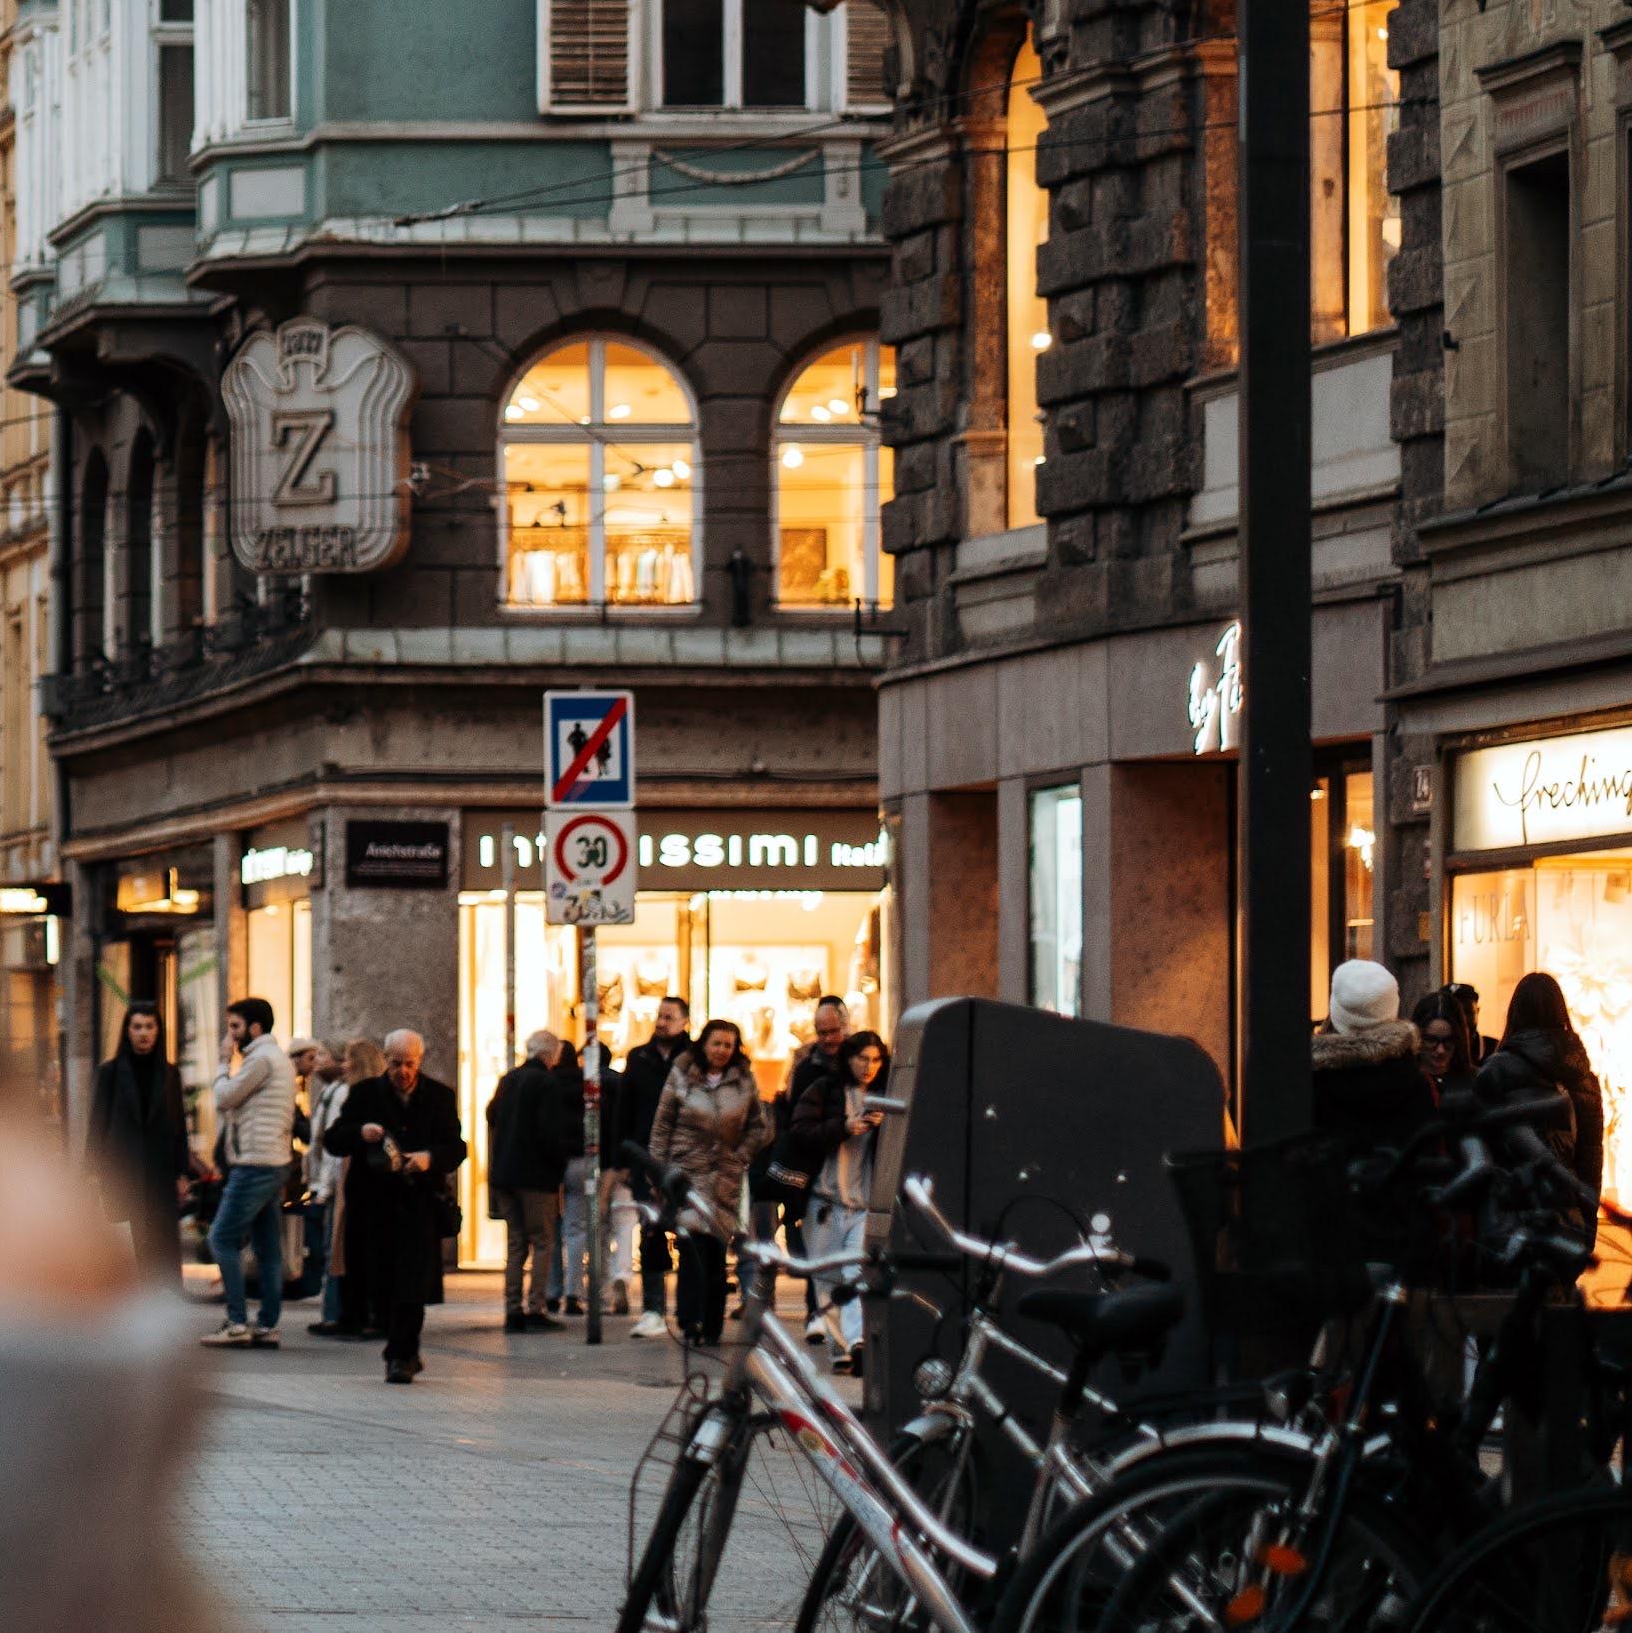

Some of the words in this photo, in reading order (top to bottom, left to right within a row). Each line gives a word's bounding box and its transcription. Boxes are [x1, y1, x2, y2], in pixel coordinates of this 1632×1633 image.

[272, 408, 337, 508] Z
[576, 835, 608, 869] 30
[1458, 891, 1531, 945] FURLA
